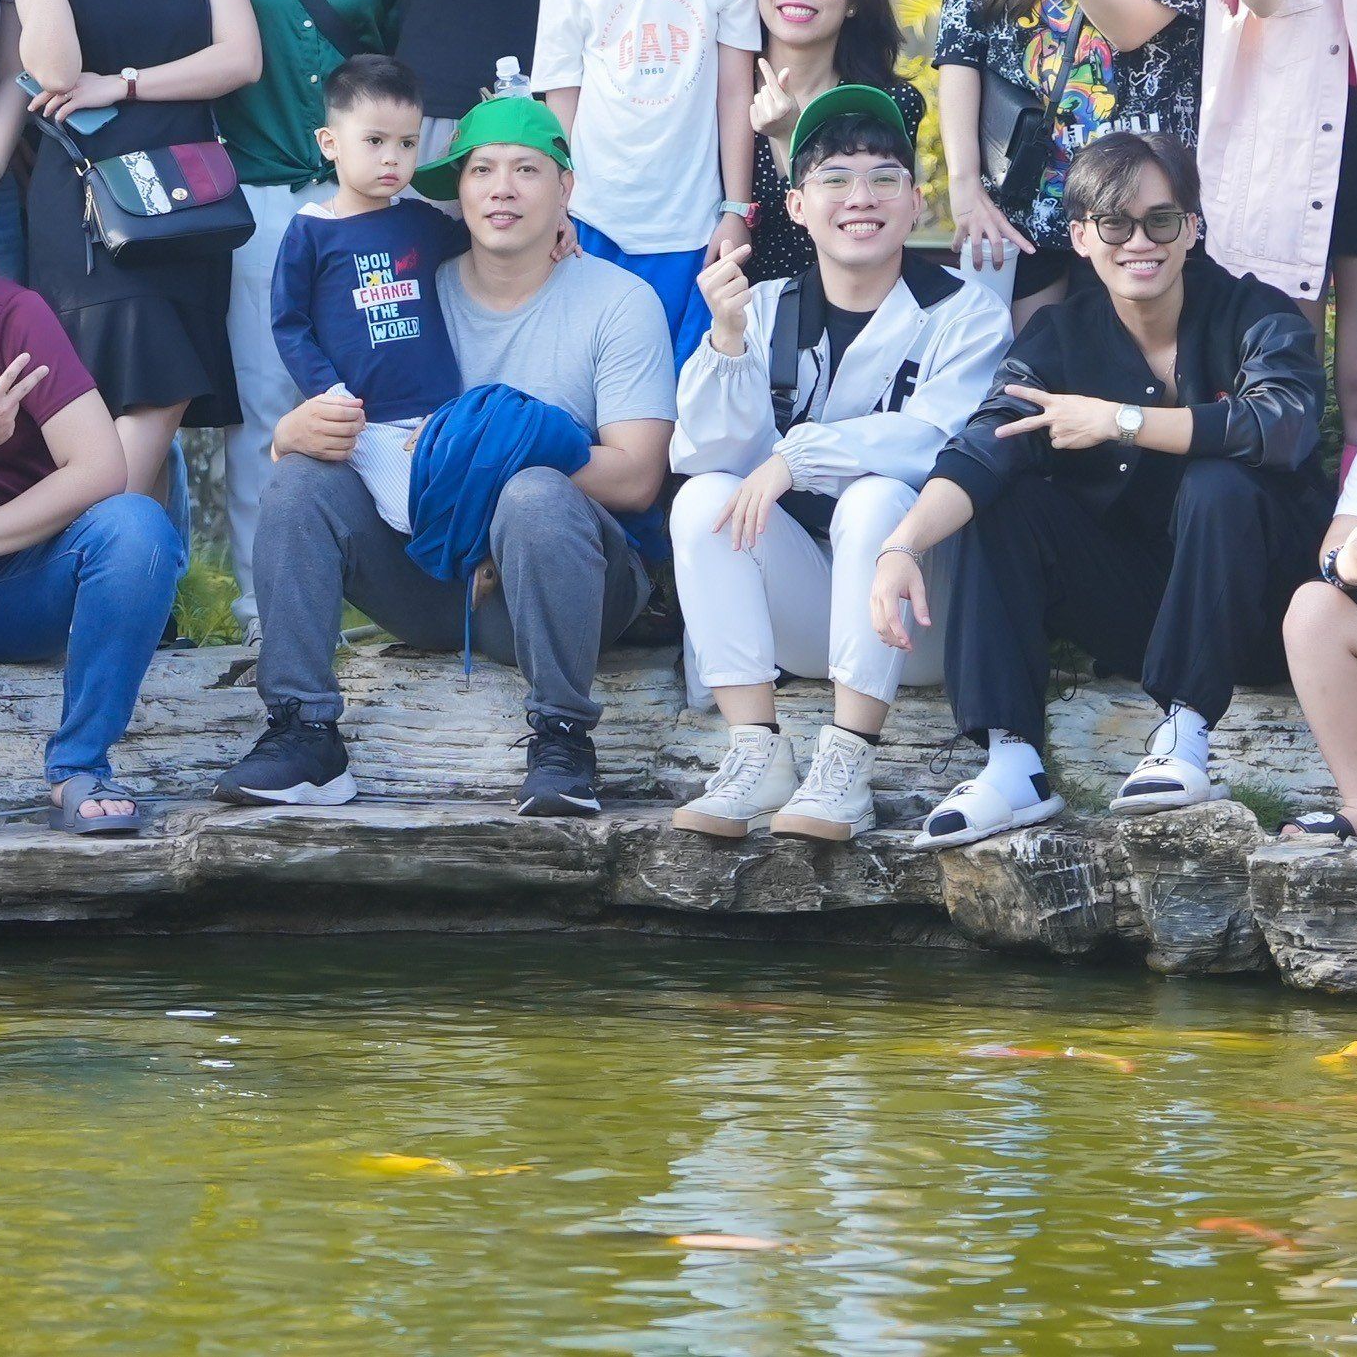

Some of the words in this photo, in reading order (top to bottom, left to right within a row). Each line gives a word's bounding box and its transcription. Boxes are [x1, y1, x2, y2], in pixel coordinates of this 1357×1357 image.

[618, 23, 691, 71] GAP
[639, 66, 665, 76] 1969
[357, 252, 392, 272] YOU
[359, 282, 414, 304] CHANGE
[368, 302, 400, 321] THE
[371, 319, 420, 341] WORLD
